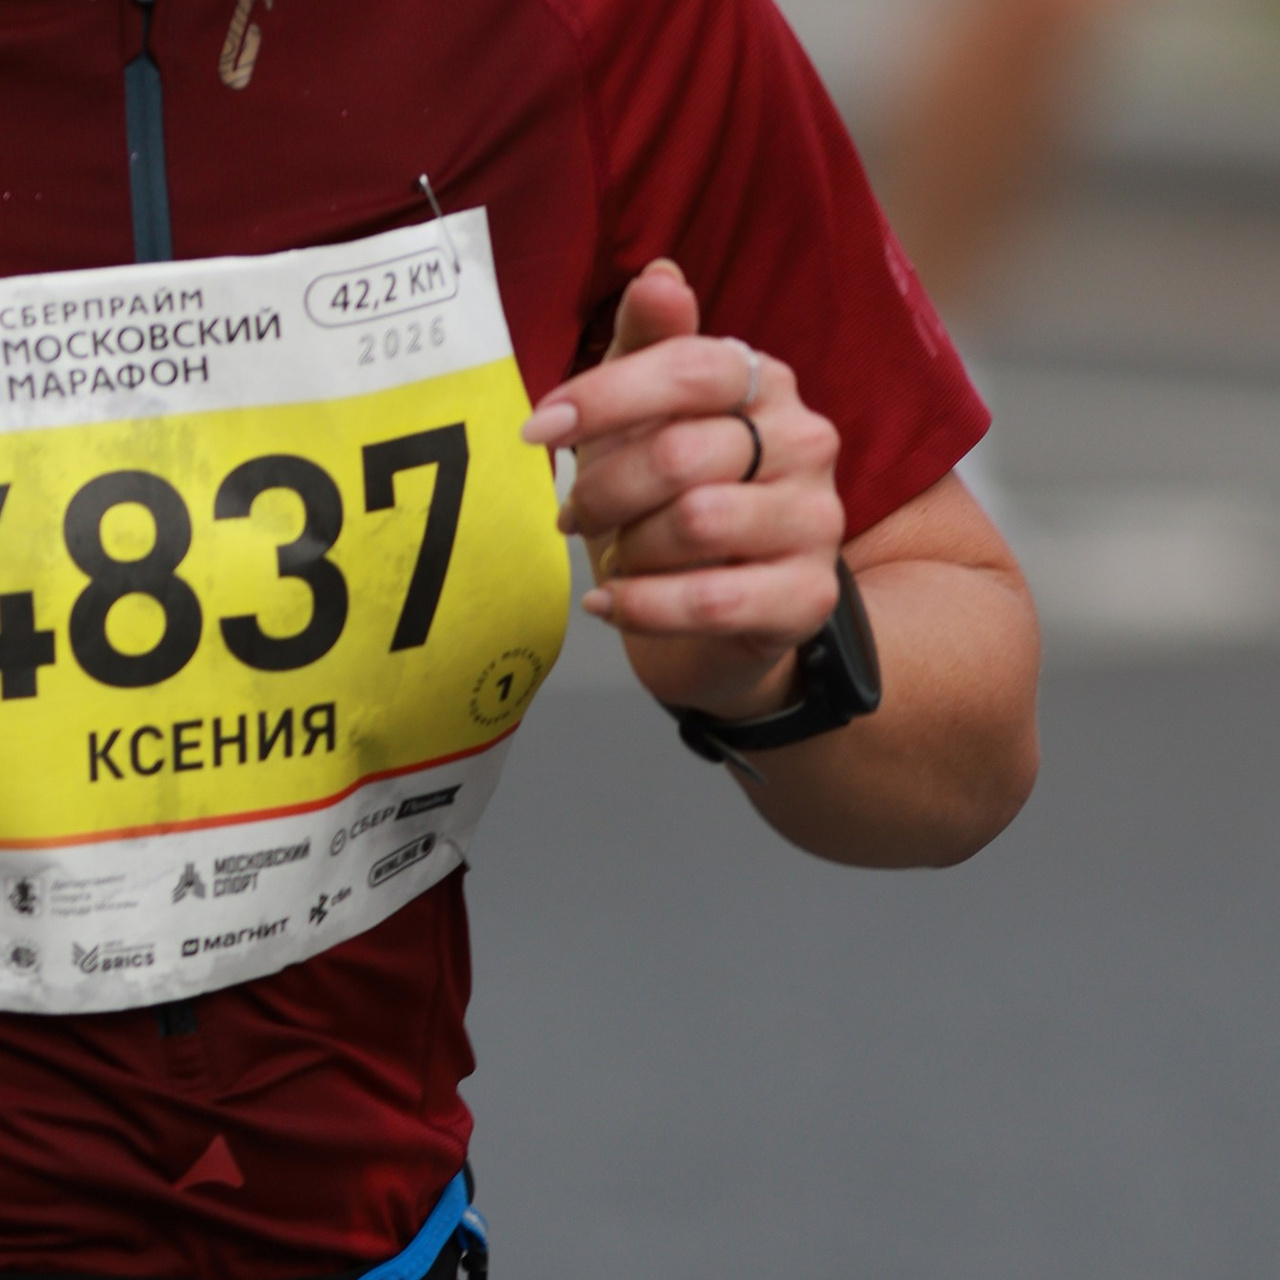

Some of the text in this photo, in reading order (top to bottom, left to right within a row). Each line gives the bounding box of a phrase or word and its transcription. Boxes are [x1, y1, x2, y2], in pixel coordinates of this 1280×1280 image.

[0, 287, 203, 330] СБЕРПРАЙМ
[330, 259, 445, 312] 42,2 КМ
[2, 306, 282, 366] МОСКОВСКИЙ
[8, 355, 209, 402] МАРАФОН
[496, 671, 515, 702] 1
[88, 701, 336, 783] КСЕНИЯ
